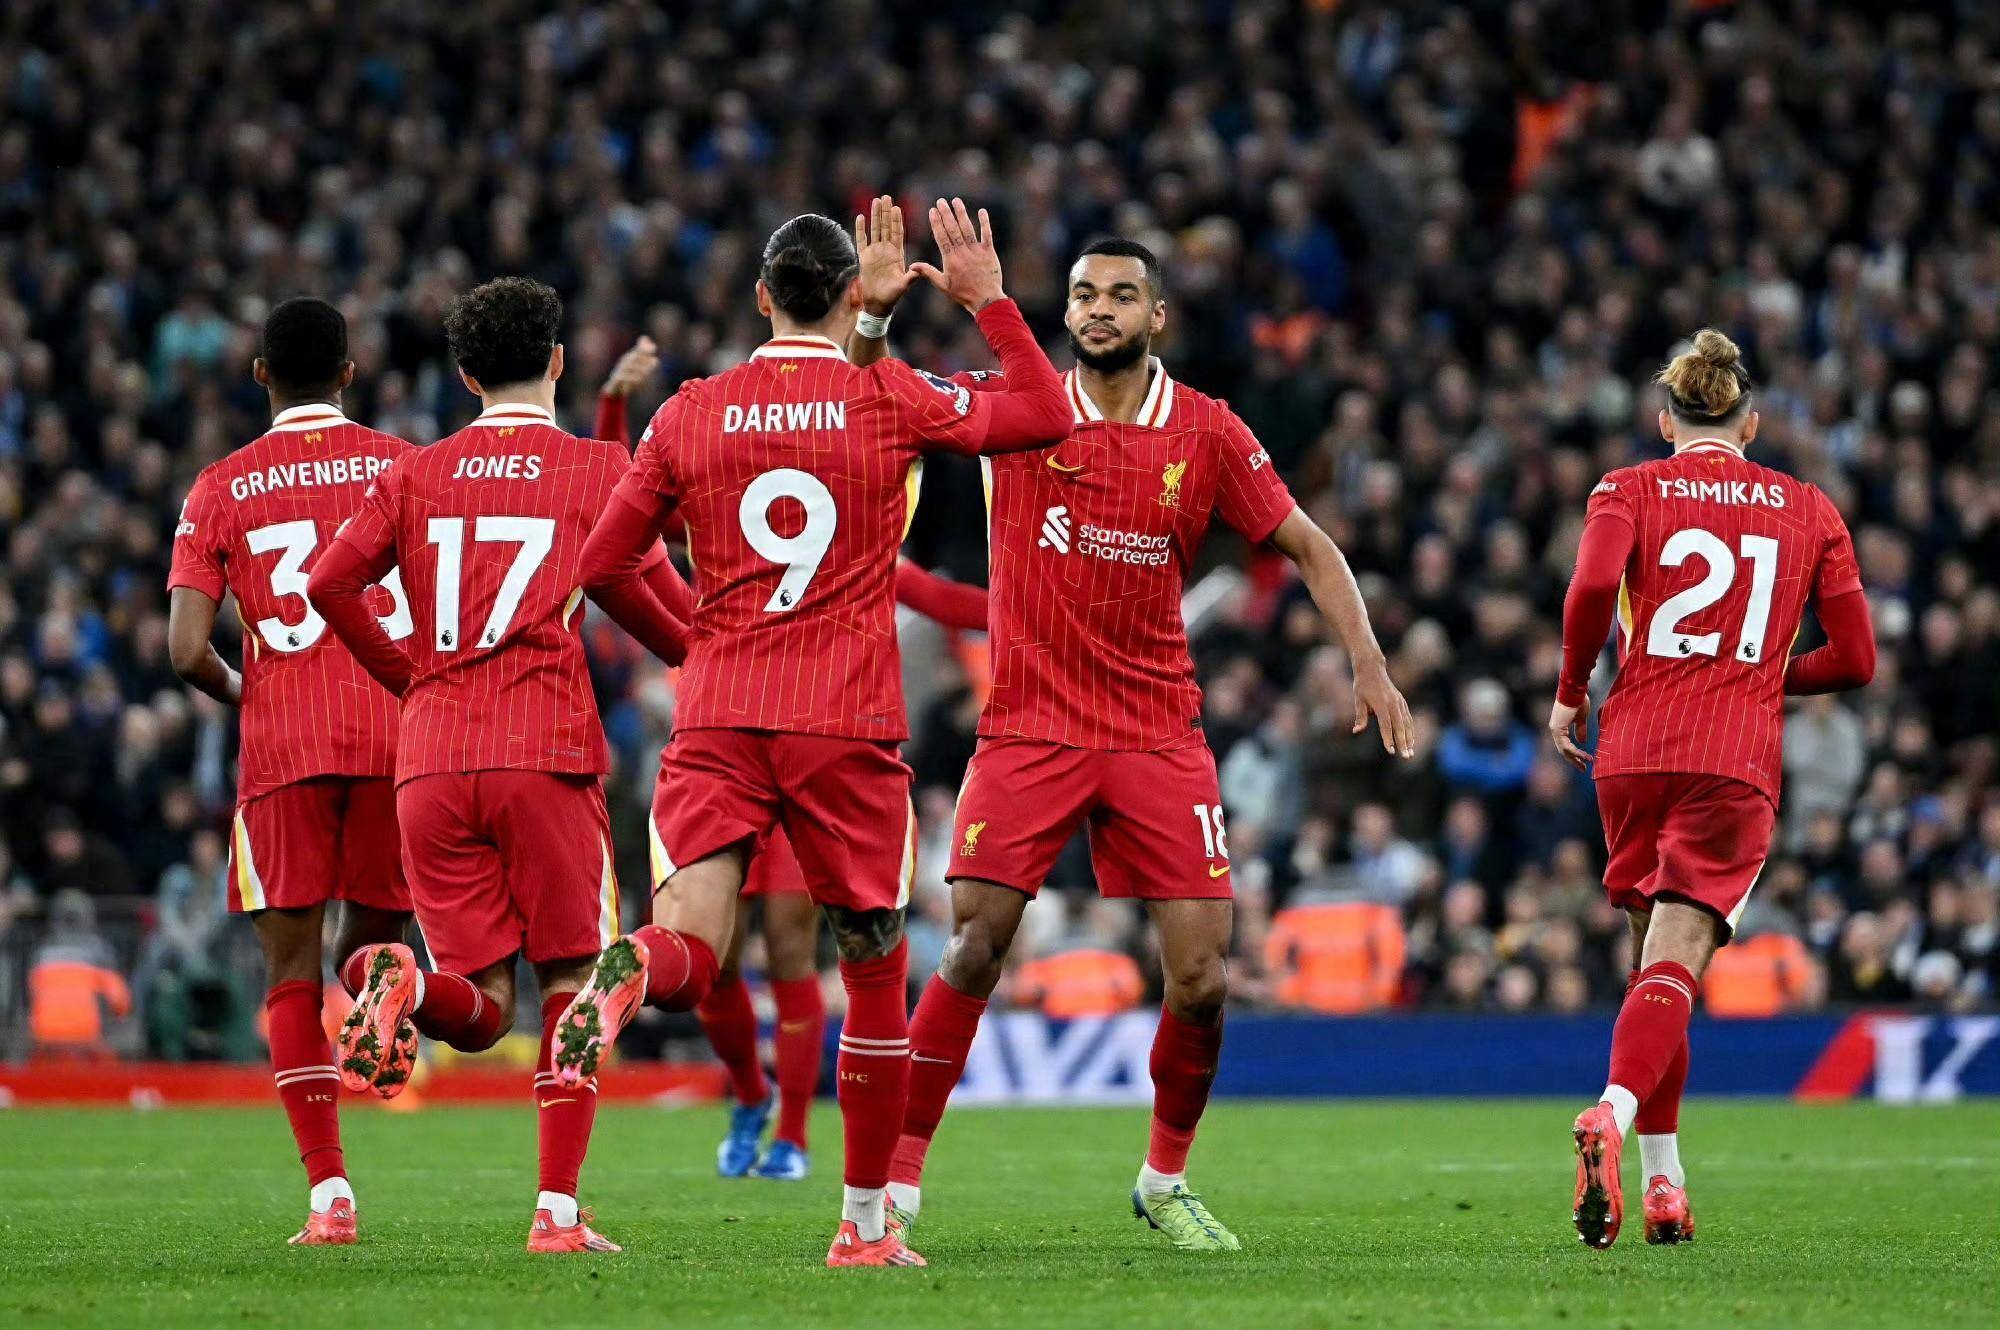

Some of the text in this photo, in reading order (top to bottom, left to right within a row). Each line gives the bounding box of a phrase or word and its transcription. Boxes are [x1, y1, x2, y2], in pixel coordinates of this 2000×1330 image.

[724, 400, 845, 432] DARWIN
[453, 455, 541, 480] JONES
[1657, 478, 1784, 508] TSIMIKAS
[739, 468, 837, 612] 9
[1079, 524, 1171, 549] standard
[1078, 541, 1170, 566] chartered
[427, 516, 555, 652] 17
[1646, 528, 1779, 664] 21
[1193, 804, 1229, 859] 18
[1643, 993, 1673, 1006] LFC
[841, 1070, 868, 1083] LFC
[307, 1094, 332, 1102] LFC
